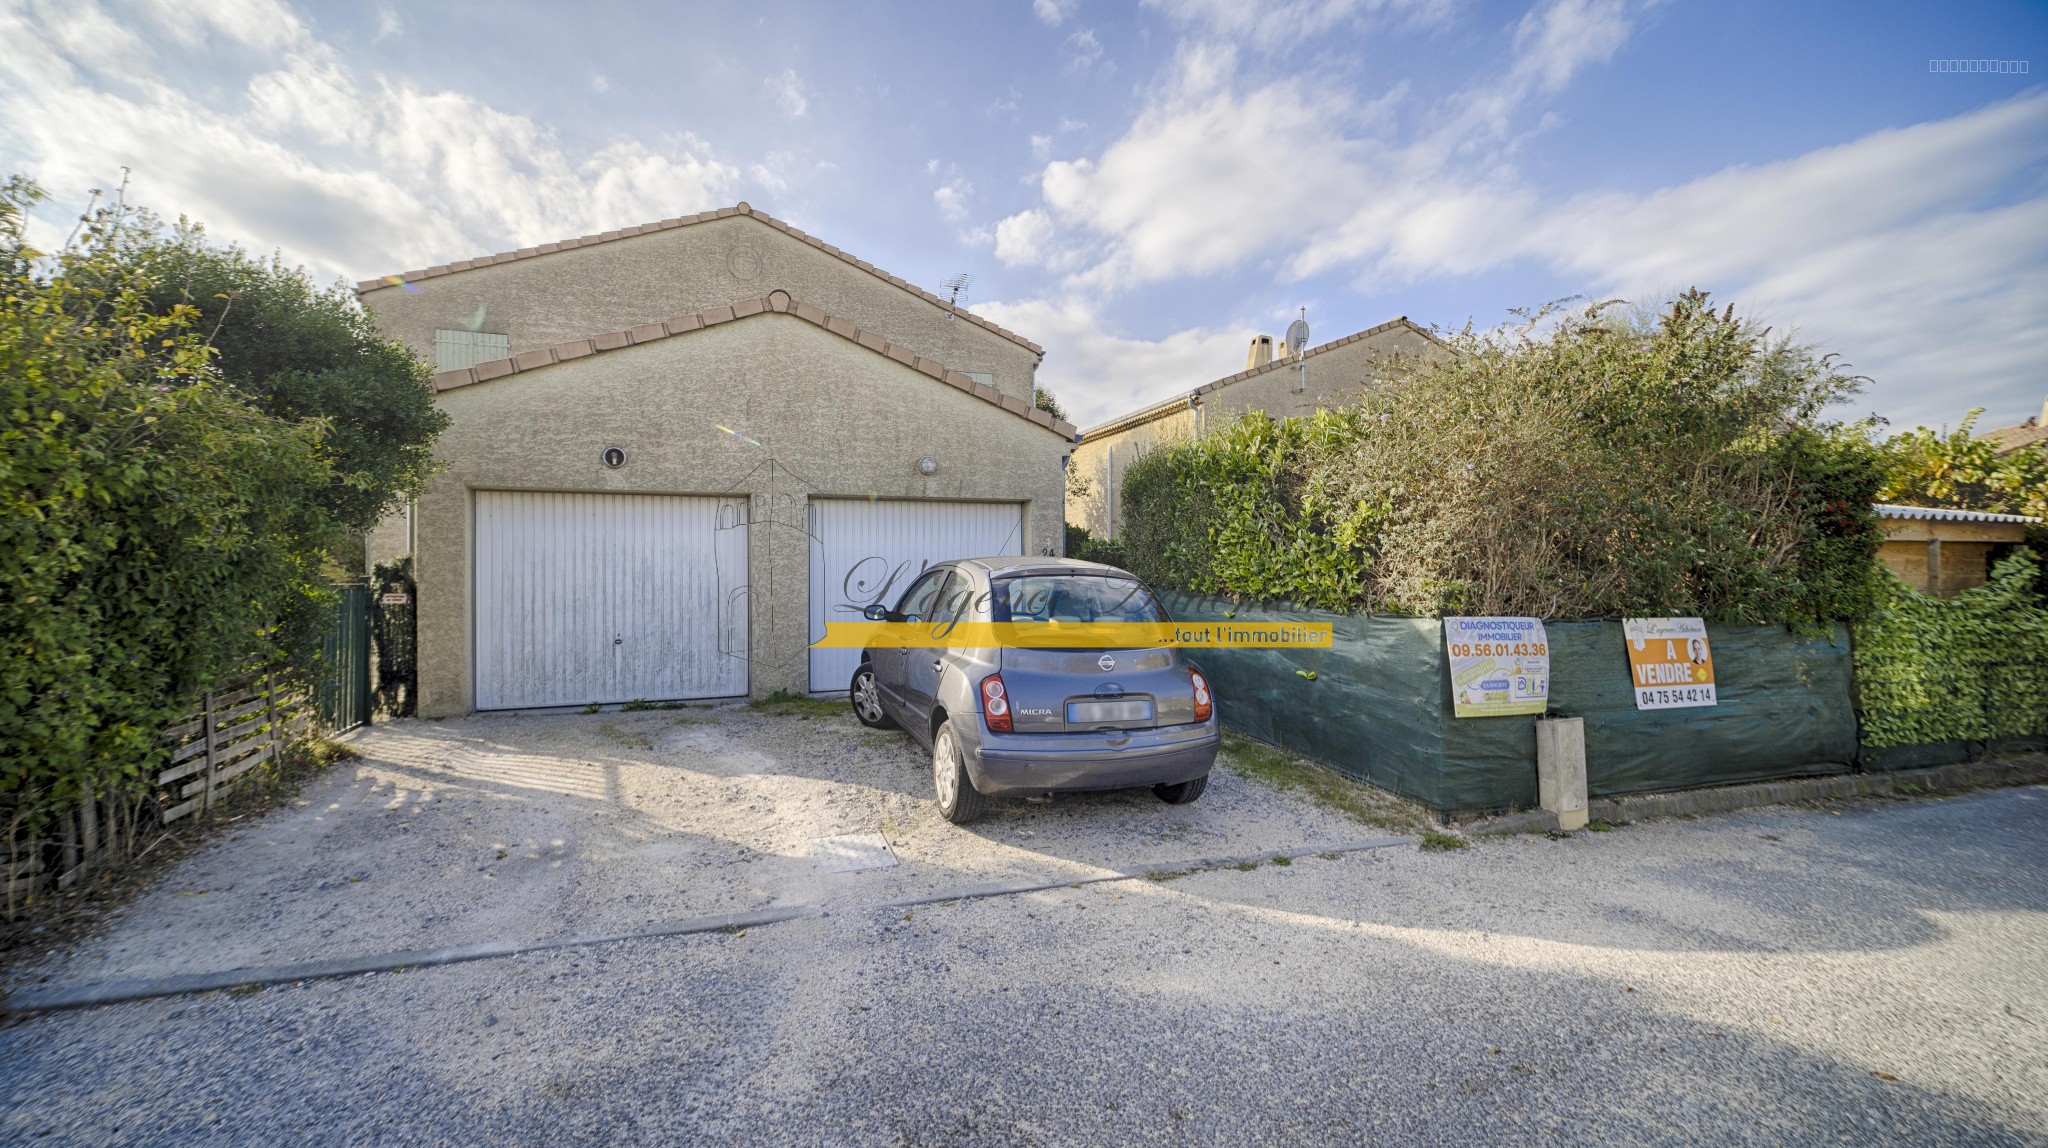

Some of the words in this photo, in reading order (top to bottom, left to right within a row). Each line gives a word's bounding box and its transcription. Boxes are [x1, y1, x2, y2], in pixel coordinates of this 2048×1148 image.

[1460, 621, 1534, 631] DIAGNOSTIQUEUR
[1477, 632, 1523, 641] IMMOBILIER
[1452, 643, 1546, 657] 09.56.01.43.36
[1666, 639, 1677, 660] A
[1636, 662, 1693, 685] VENDRE
[1642, 691, 1654, 705] 04
[1657, 690, 1669, 704] 75
[1672, 689, 1684, 703] 54
[1686, 689, 1697, 702] 42
[1700, 688, 1711, 701] 14
[1020, 708, 1052, 716] MICRA
